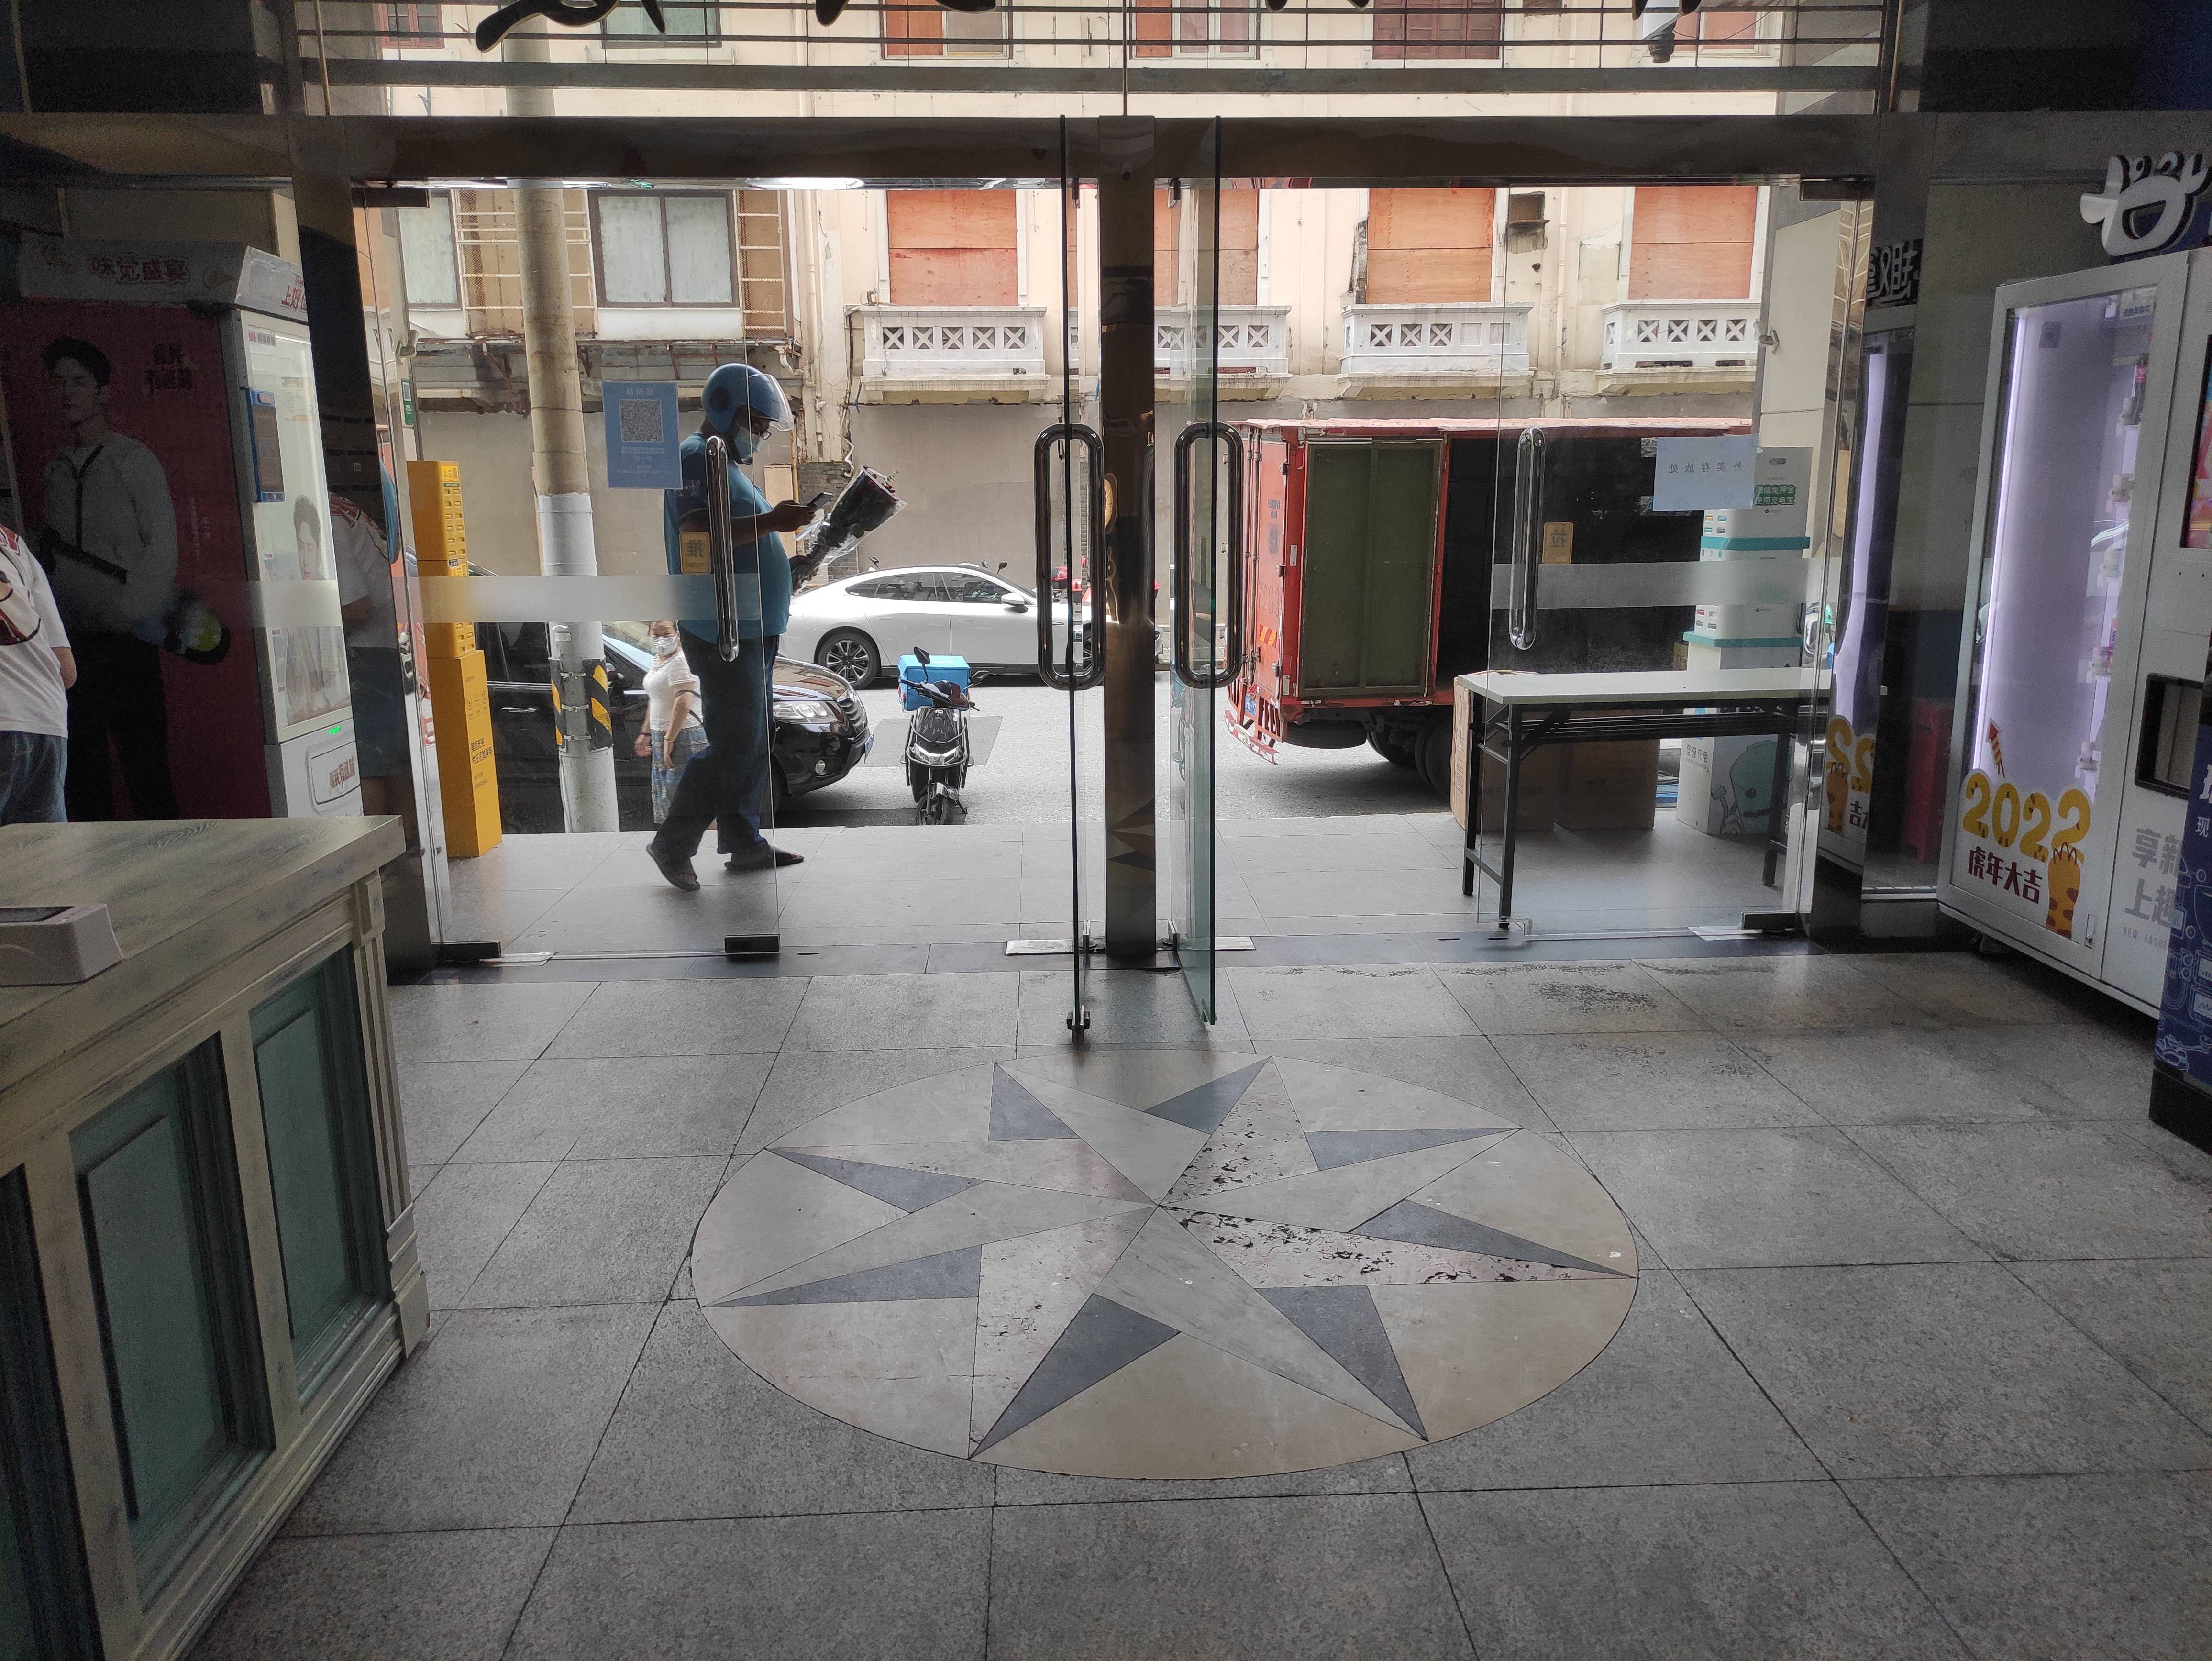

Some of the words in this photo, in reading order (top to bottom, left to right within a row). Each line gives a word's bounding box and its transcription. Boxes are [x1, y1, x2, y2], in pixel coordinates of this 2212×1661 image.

[1687, 744, 1708, 763] 怪兽充电
[1962, 773, 2091, 866] 2022
[2195, 816, 2210, 838] 现
[1968, 846, 2043, 904] 虎年大吉
